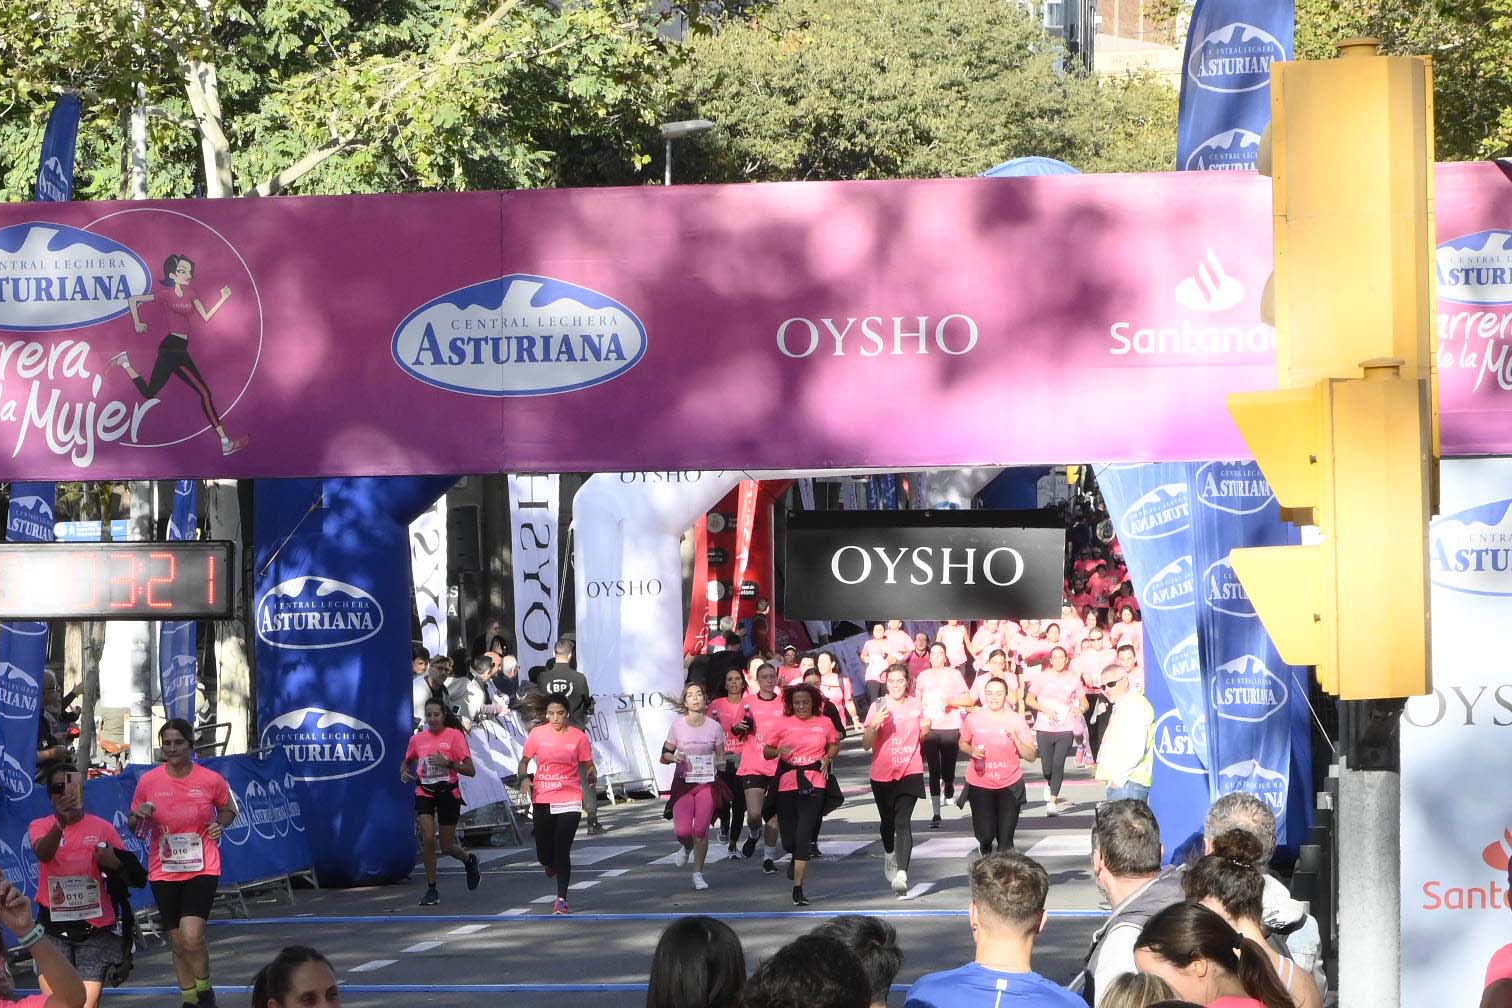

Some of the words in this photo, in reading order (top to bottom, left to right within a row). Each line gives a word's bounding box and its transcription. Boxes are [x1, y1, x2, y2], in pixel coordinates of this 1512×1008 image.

[48, 258, 128, 269] LECHERA
[449, 316, 531, 332] CENTRAL
[536, 313, 619, 329] LECHERA
[411, 321, 628, 367] ASTURIANA
[775, 314, 979, 359] OYSHO
[12, 375, 162, 469] Mujer
[831, 545, 1025, 588] OYSHO
[586, 578, 663, 600] OYSHO
[261, 608, 374, 634] ASTURIANA
[553, 683, 568, 693] BP
